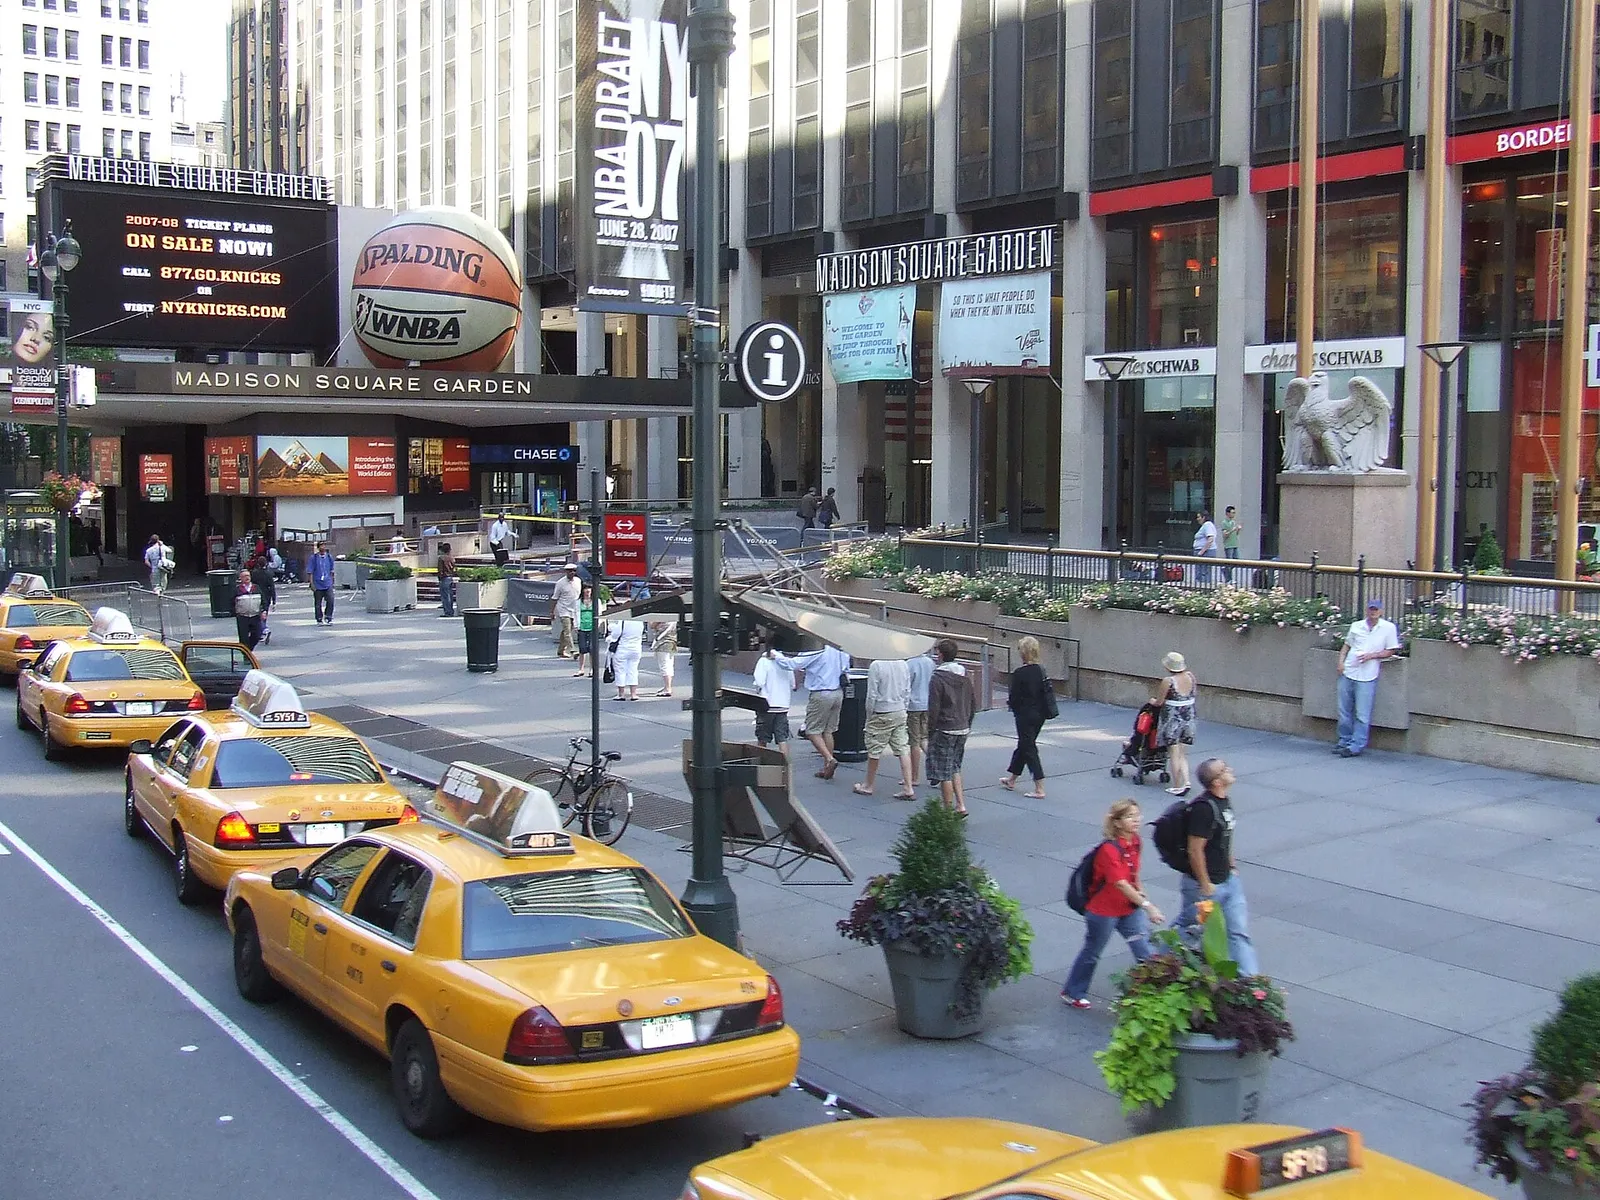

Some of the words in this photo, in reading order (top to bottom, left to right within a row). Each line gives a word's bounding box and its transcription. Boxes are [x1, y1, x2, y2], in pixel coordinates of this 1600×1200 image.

[595, 12, 635, 129] DRAFT
[630, 17, 689, 120] NY
[1496, 123, 1571, 151] BORDE
[67, 155, 159, 187] MADISON
[171, 165, 242, 194] SQUARE
[253, 171, 322, 200] GARDEN
[626, 121, 682, 221] 07
[594, 151, 632, 217] NBA
[126, 215, 179, 228] 2007-08
[185, 218, 231, 231] TICKET
[233, 222, 273, 234] PLANS
[596, 219, 628, 238] JUNE
[630, 221, 649, 241] 28,
[650, 224, 678, 242] 2007
[126, 233, 155, 249] ON
[162, 236, 213, 252] SALE
[218, 239, 273, 257] NOW!
[360, 243, 483, 284] SPALDING
[816, 248, 892, 292] MADISON
[898, 239, 968, 283] SQUARE
[975, 229, 1053, 273] GARDEN
[122, 267, 151, 277] CALL
[160, 266, 281, 285] 877.GO.KNICKS
[197, 286, 212, 295] OR
[587, 285, 630, 297] lenovo
[953, 295, 961, 305] SO
[962, 293, 975, 304] THIS
[977, 292, 983, 303] IS
[985, 292, 1000, 303] WHAT
[1001, 290, 1023, 302] PEOPLE
[1025, 289, 1035, 300] DO
[123, 303, 155, 313] VISIT
[161, 301, 287, 319] NYKNICKS.COM
[950, 307, 965, 318] WHEN
[967, 306, 990, 317] THEY'RE
[991, 305, 1003, 315] NOT
[1005, 304, 1012, 315] IN
[1014, 303, 1036, 315] VEGAS.
[372, 310, 460, 340] WNBA
[841, 323, 873, 333] WELCOME
[841, 333, 854, 341] THE
[854, 330, 883, 339] GARDEN
[859, 339, 892, 348] THROUGH
[876, 347, 896, 355] FANS
[1260, 348, 1317, 369] chars
[1318, 349, 1383, 366] SCHWAB
[16, 366, 51, 376] beauty
[1146, 359, 1200, 374] SCHWAB
[20, 373, 51, 383] capital
[175, 370, 300, 388] MADISON
[316, 374, 421, 391] SQUARE
[433, 378, 531, 394] GARDEN
[13, 397, 54, 406] COSMOPOLITAN
[514, 449, 557, 460] CHASE
[144, 467, 165, 475] phone.
[1454, 471, 1498, 489] SCH
[616, 532, 643, 542] Standing
[273, 712, 295, 722] 5Y51
